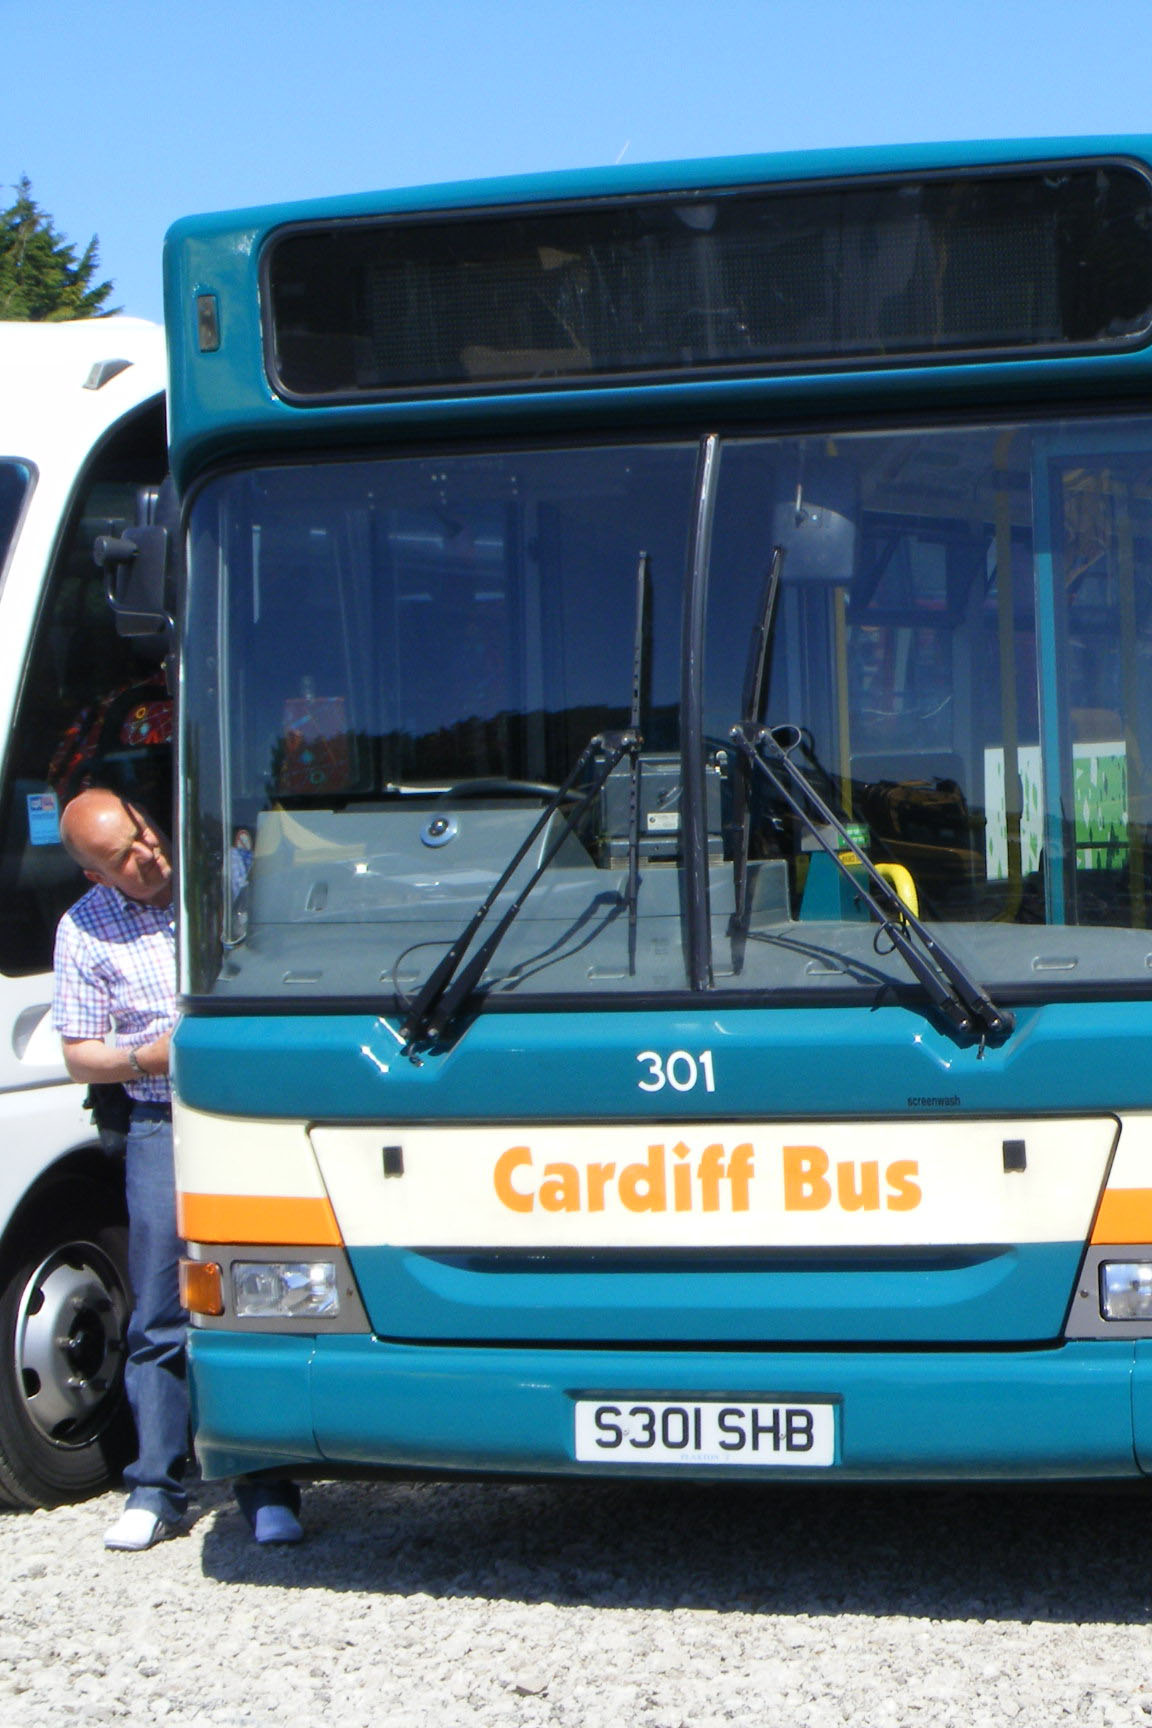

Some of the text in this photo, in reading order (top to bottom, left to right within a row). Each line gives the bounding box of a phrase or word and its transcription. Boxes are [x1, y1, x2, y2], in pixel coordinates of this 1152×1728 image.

[636, 1050, 716, 1093] 301
[907, 1095, 961, 1106] screenwash
[493, 1141, 922, 1213] Cardiff Bus
[594, 1405, 814, 1452] S301 SHB
